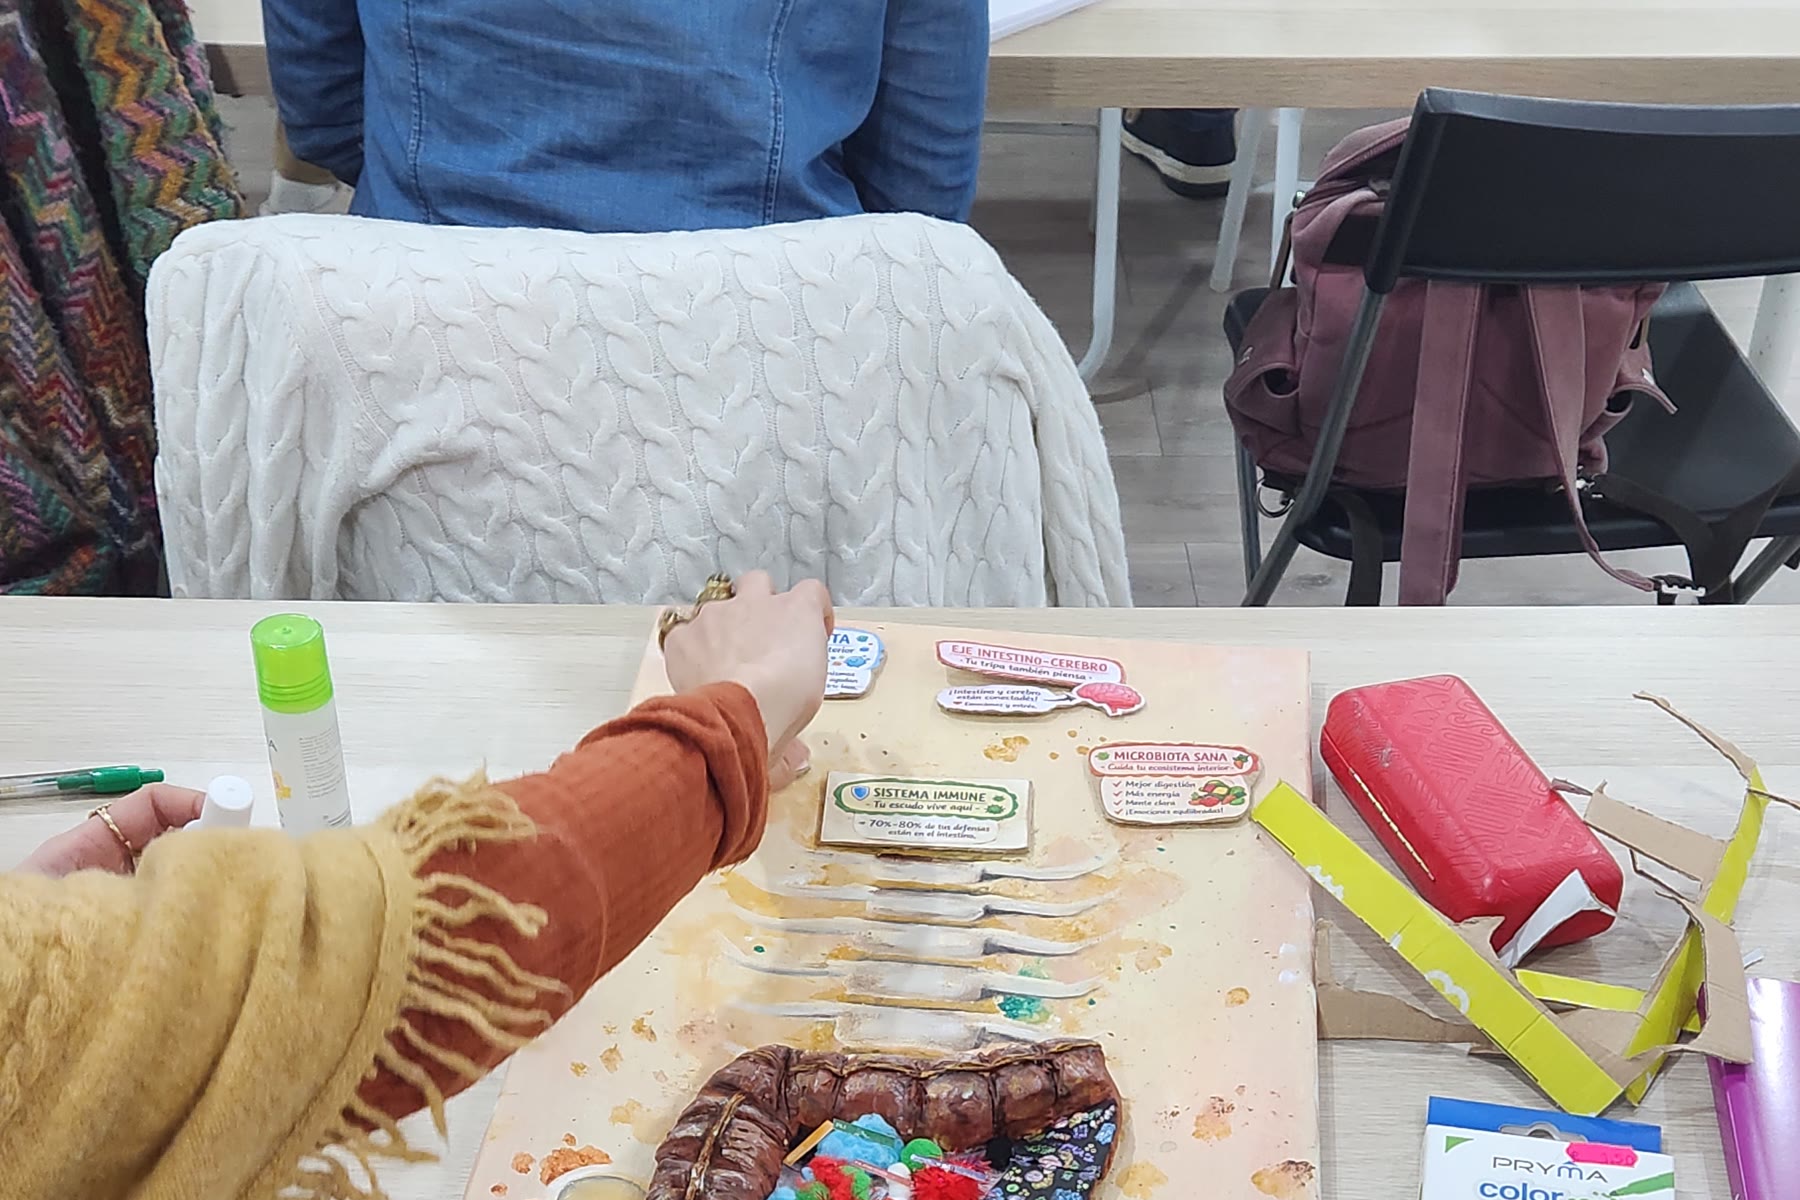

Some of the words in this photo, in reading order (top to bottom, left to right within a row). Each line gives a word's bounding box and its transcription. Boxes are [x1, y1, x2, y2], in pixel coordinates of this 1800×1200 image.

[828, 646, 854, 654] terior
[952, 644, 973, 655] EJE
[965, 658, 977, 666] Tu
[981, 660, 1005, 671] tripa
[1009, 664, 1050, 676] también
[1052, 670, 1087, 681] piensa
[1114, 751, 1190, 762] MICROBIOTA
[1194, 752, 1228, 762] SANA
[1108, 763, 1134, 771] Cuida
[1148, 764, 1195, 772] ecosistema
[1125, 781, 1152, 789] Mejor
[1154, 781, 1196, 789] digestión
[873, 788, 929, 800] SISTEMA
[933, 790, 986, 802] IMMUNE
[1147, 791, 1180, 799] energía
[874, 801, 886, 809] Tu
[889, 802, 924, 811] escudo
[926, 802, 947, 811] vive
[950, 803, 973, 813] aquí
[925, 822, 935, 830] de
[937, 823, 951, 831] tus
[953, 823, 990, 833] defensas
